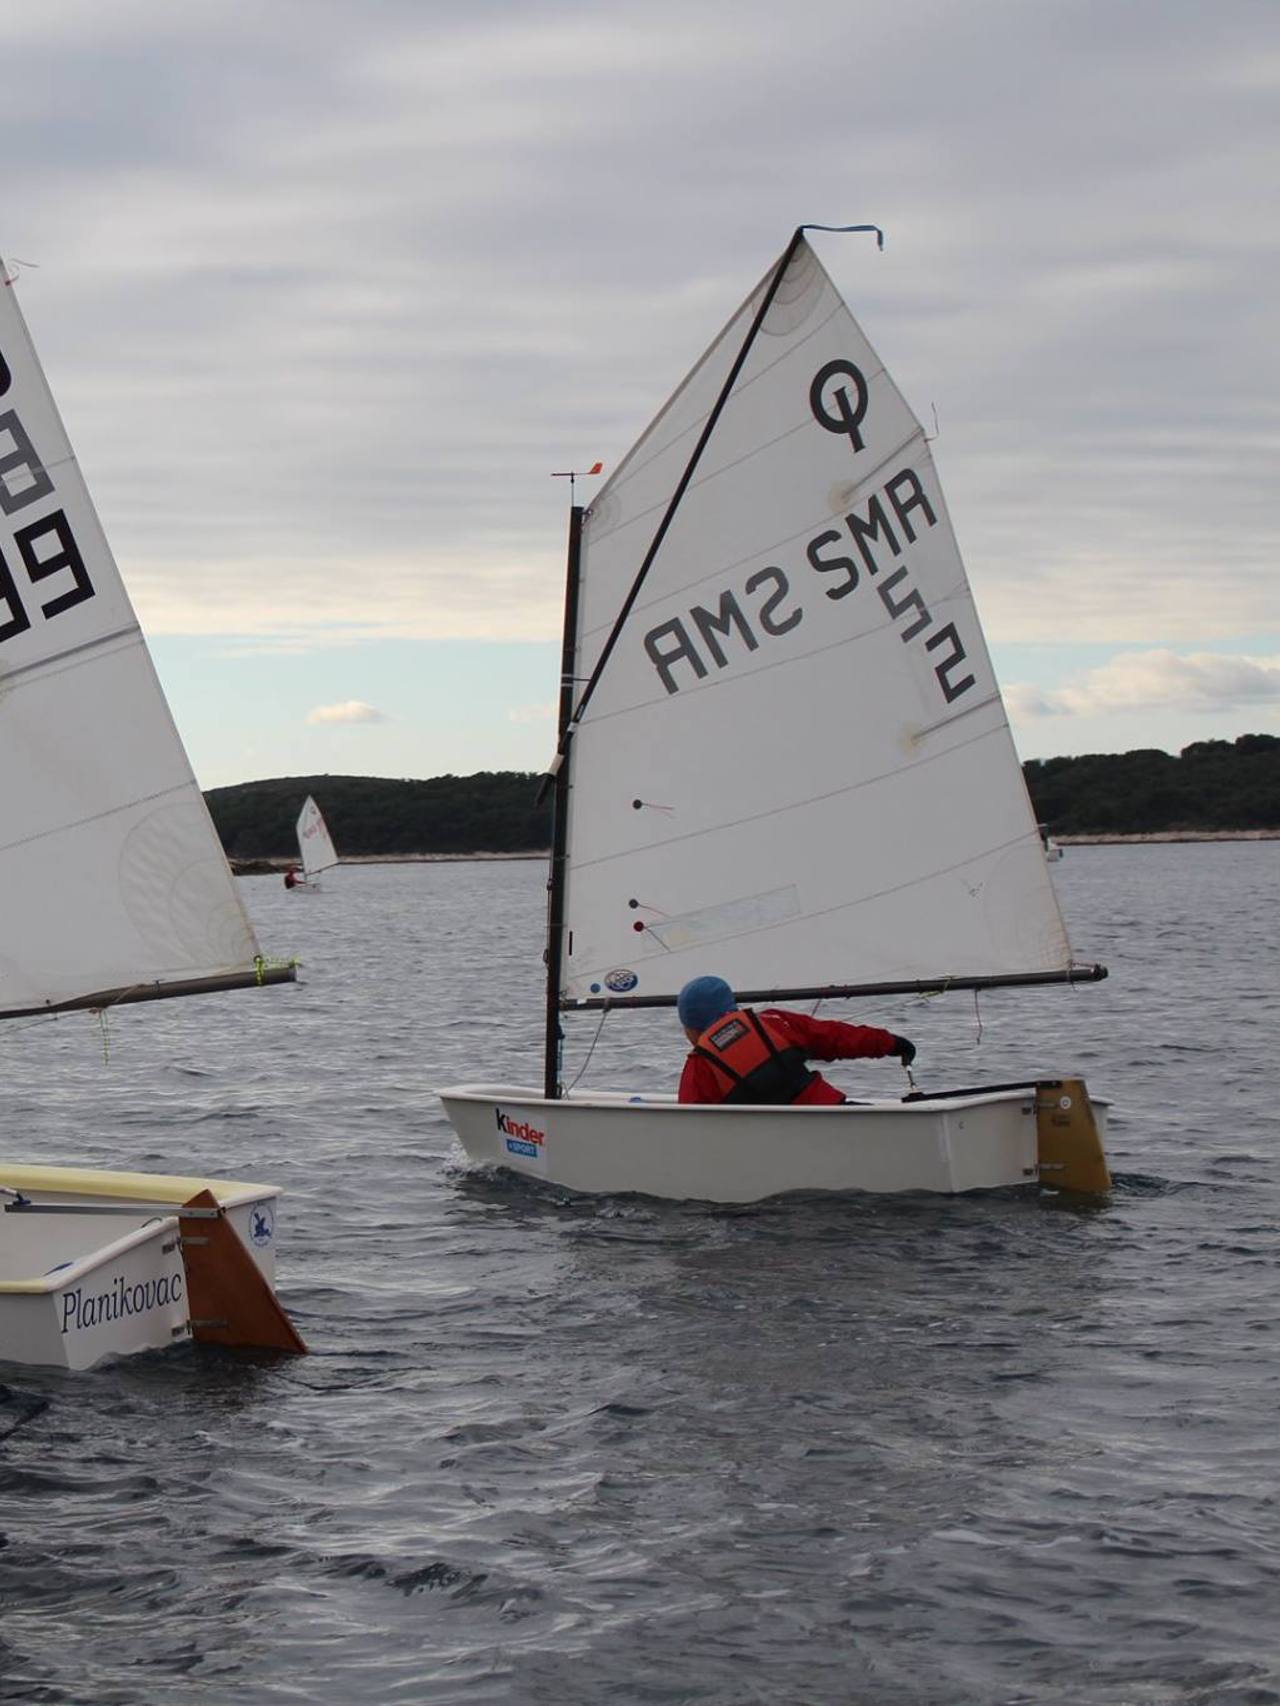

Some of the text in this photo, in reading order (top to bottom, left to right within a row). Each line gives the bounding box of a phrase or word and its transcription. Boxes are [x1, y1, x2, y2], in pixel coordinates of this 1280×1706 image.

[806, 468, 937, 600] SMA
[925, 622, 976, 704] 2
[61, 1273, 183, 1333] Planikovac
